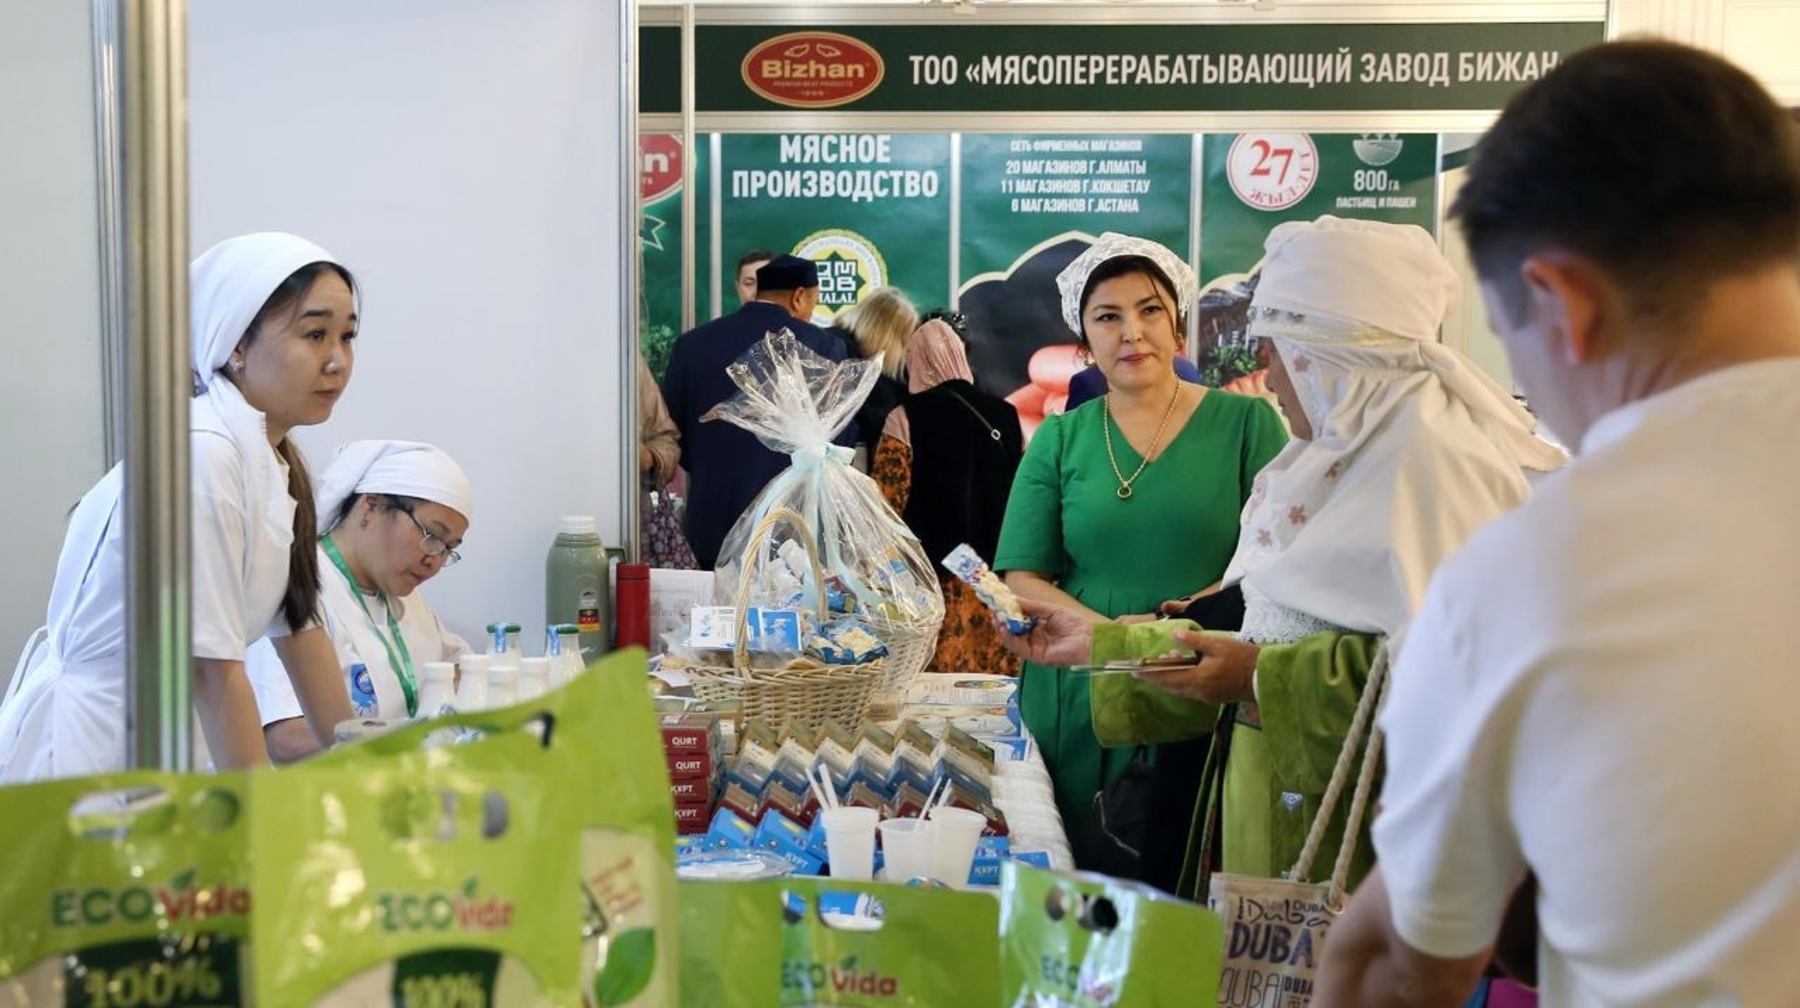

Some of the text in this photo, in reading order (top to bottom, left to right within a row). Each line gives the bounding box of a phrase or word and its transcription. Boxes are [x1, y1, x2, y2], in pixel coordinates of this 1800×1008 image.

[762, 60, 865, 78] Bizhan
[909, 55, 958, 84] ТОО
[965, 48, 1351, 88] «МЯСОПЕРЕРАБАТЫВАЮЩИЙ
[1360, 53, 1450, 87] ЗАВОД
[780, 135, 891, 163] МЯСНОЕ
[1006, 160, 1147, 174] 20 МАГАЗИНОВ Г.АЛМАТЫ
[1249, 139, 1294, 185] 27
[732, 170, 939, 202] ПРОИЗВОДСТВО
[1001, 179, 1151, 193] 11 МАГАЗИНОВ Г.КОКШЕТАУ
[1353, 169, 1388, 191] 800
[1011, 198, 1139, 212] 6 МАГАЗИНОВ Г.АСТАНА
[672, 737, 698, 746] QURT
[675, 761, 701, 770] QURT
[1228, 921, 1326, 969] DUBA
